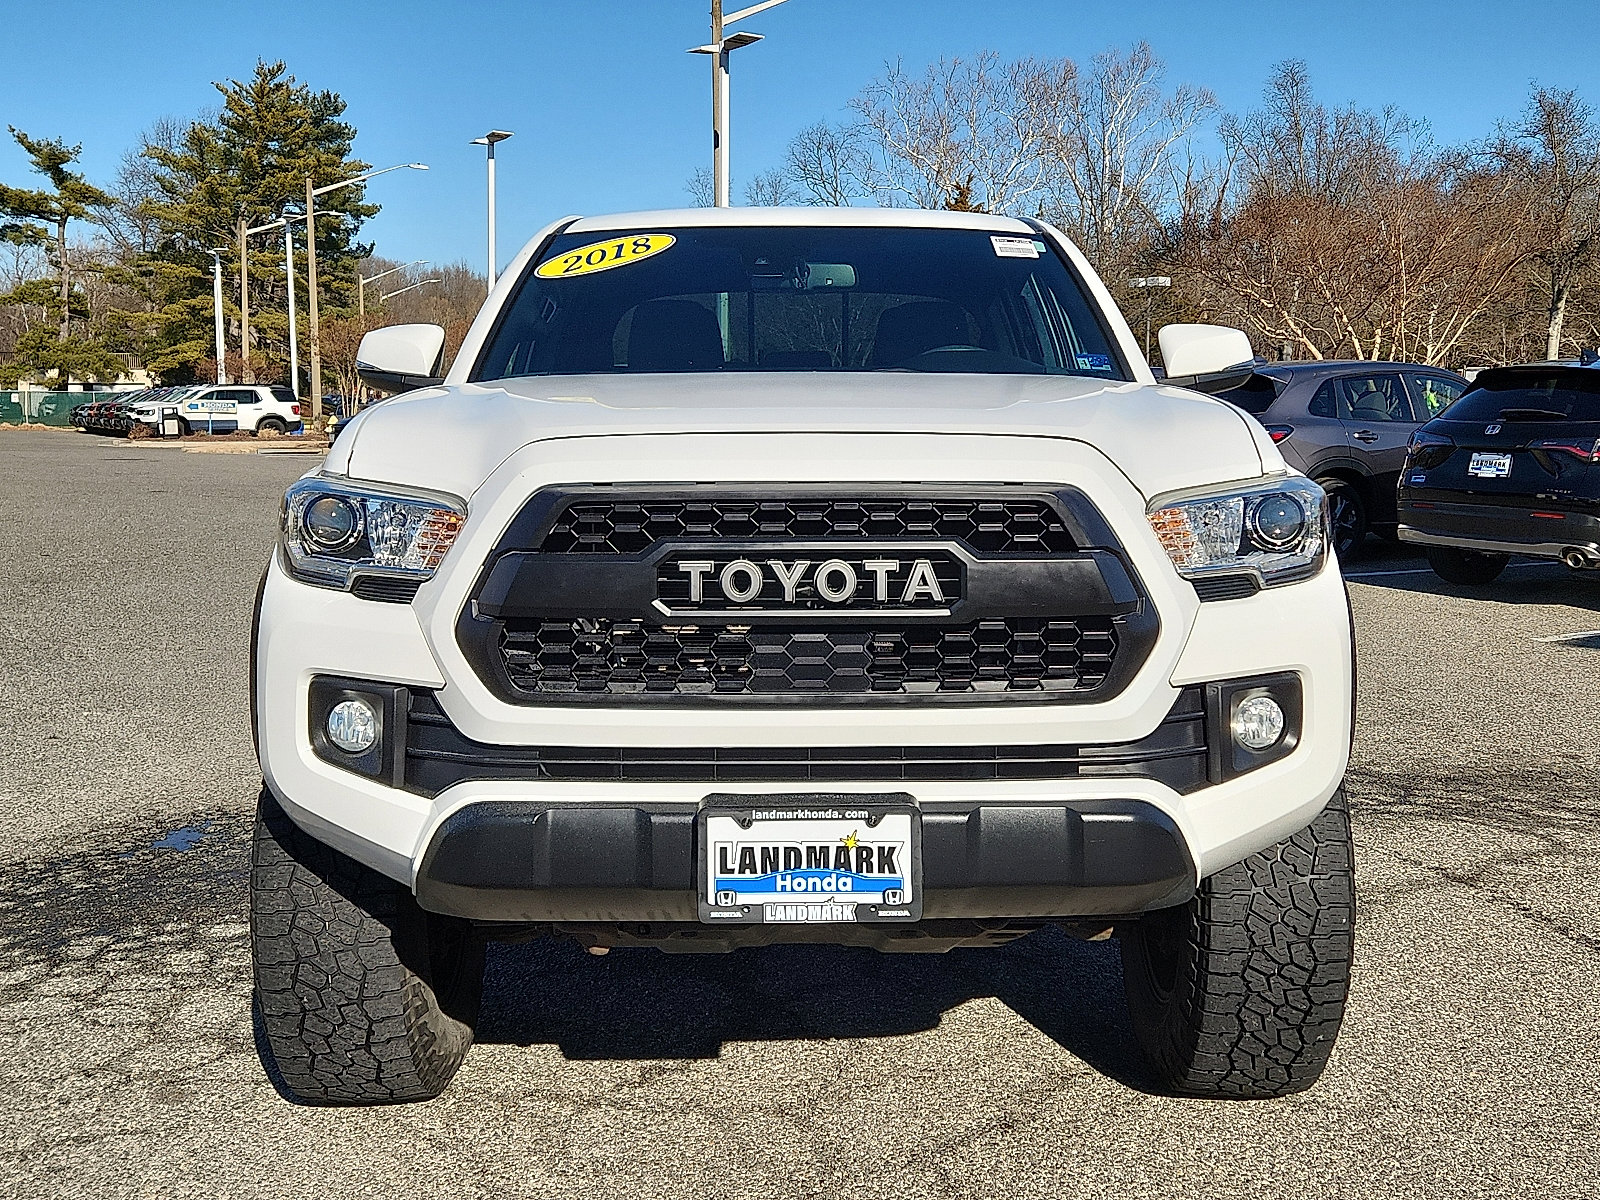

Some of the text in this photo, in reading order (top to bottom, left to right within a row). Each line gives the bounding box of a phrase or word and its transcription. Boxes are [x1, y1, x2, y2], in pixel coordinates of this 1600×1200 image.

[562, 237, 652, 274] 2018
[677, 558, 945, 604] TOYOTA
[719, 845, 898, 875] LANDMARK
[776, 874, 853, 892] Honda
[764, 904, 856, 922] LANDMARK
